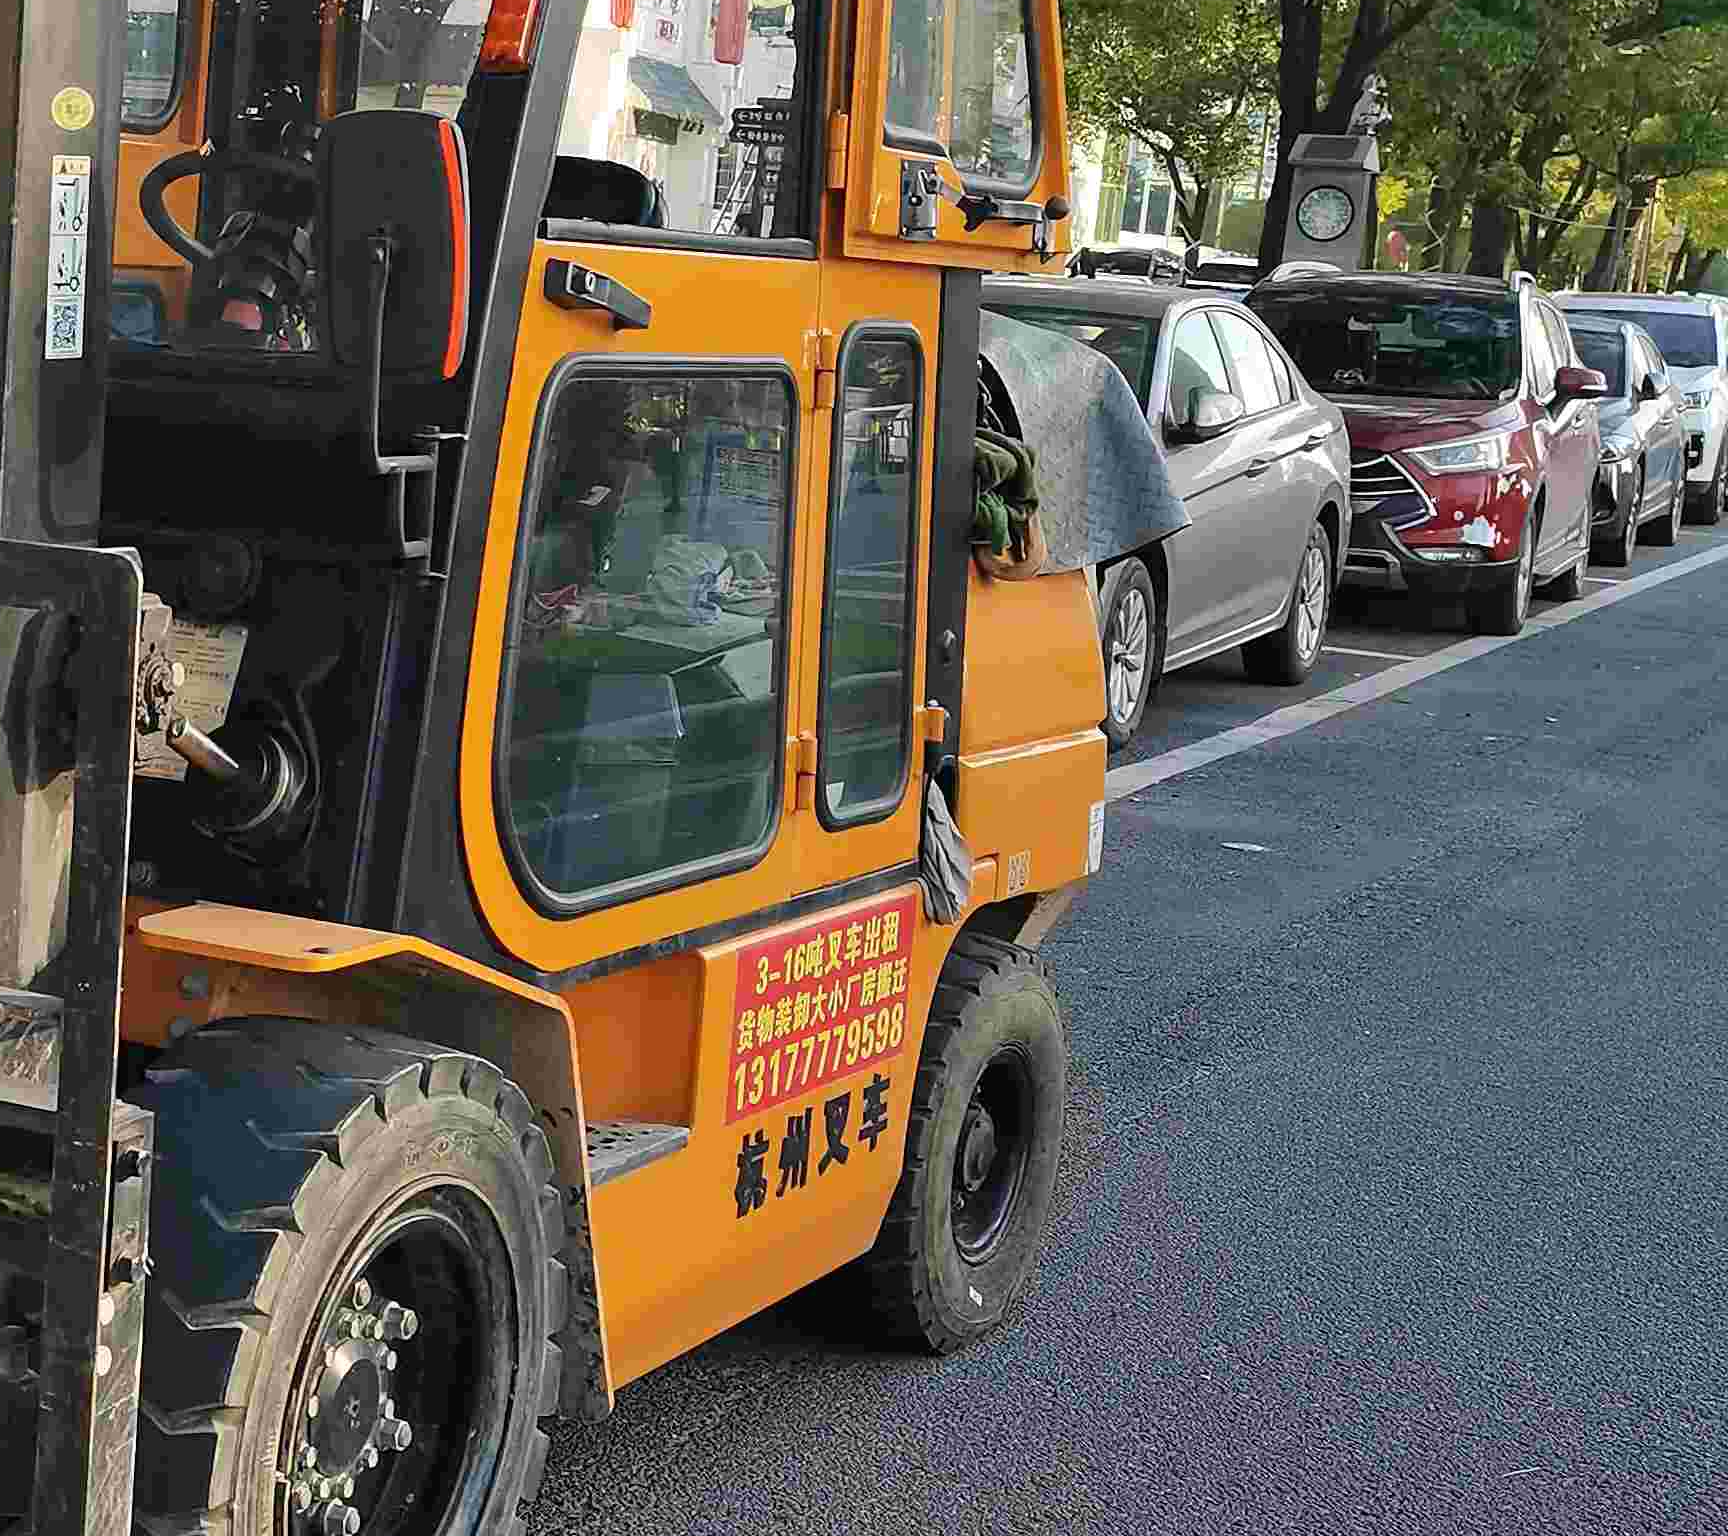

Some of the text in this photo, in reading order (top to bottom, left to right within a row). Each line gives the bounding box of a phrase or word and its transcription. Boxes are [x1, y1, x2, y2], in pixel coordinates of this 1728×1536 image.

[755, 911, 901, 995] 3-16吨叉车出租
[735, 1002, 905, 1112] 13177779598
[736, 957, 907, 1054] 货物装卸大小厂房搬迁
[734, 1072, 891, 1220] 杭州叉车
